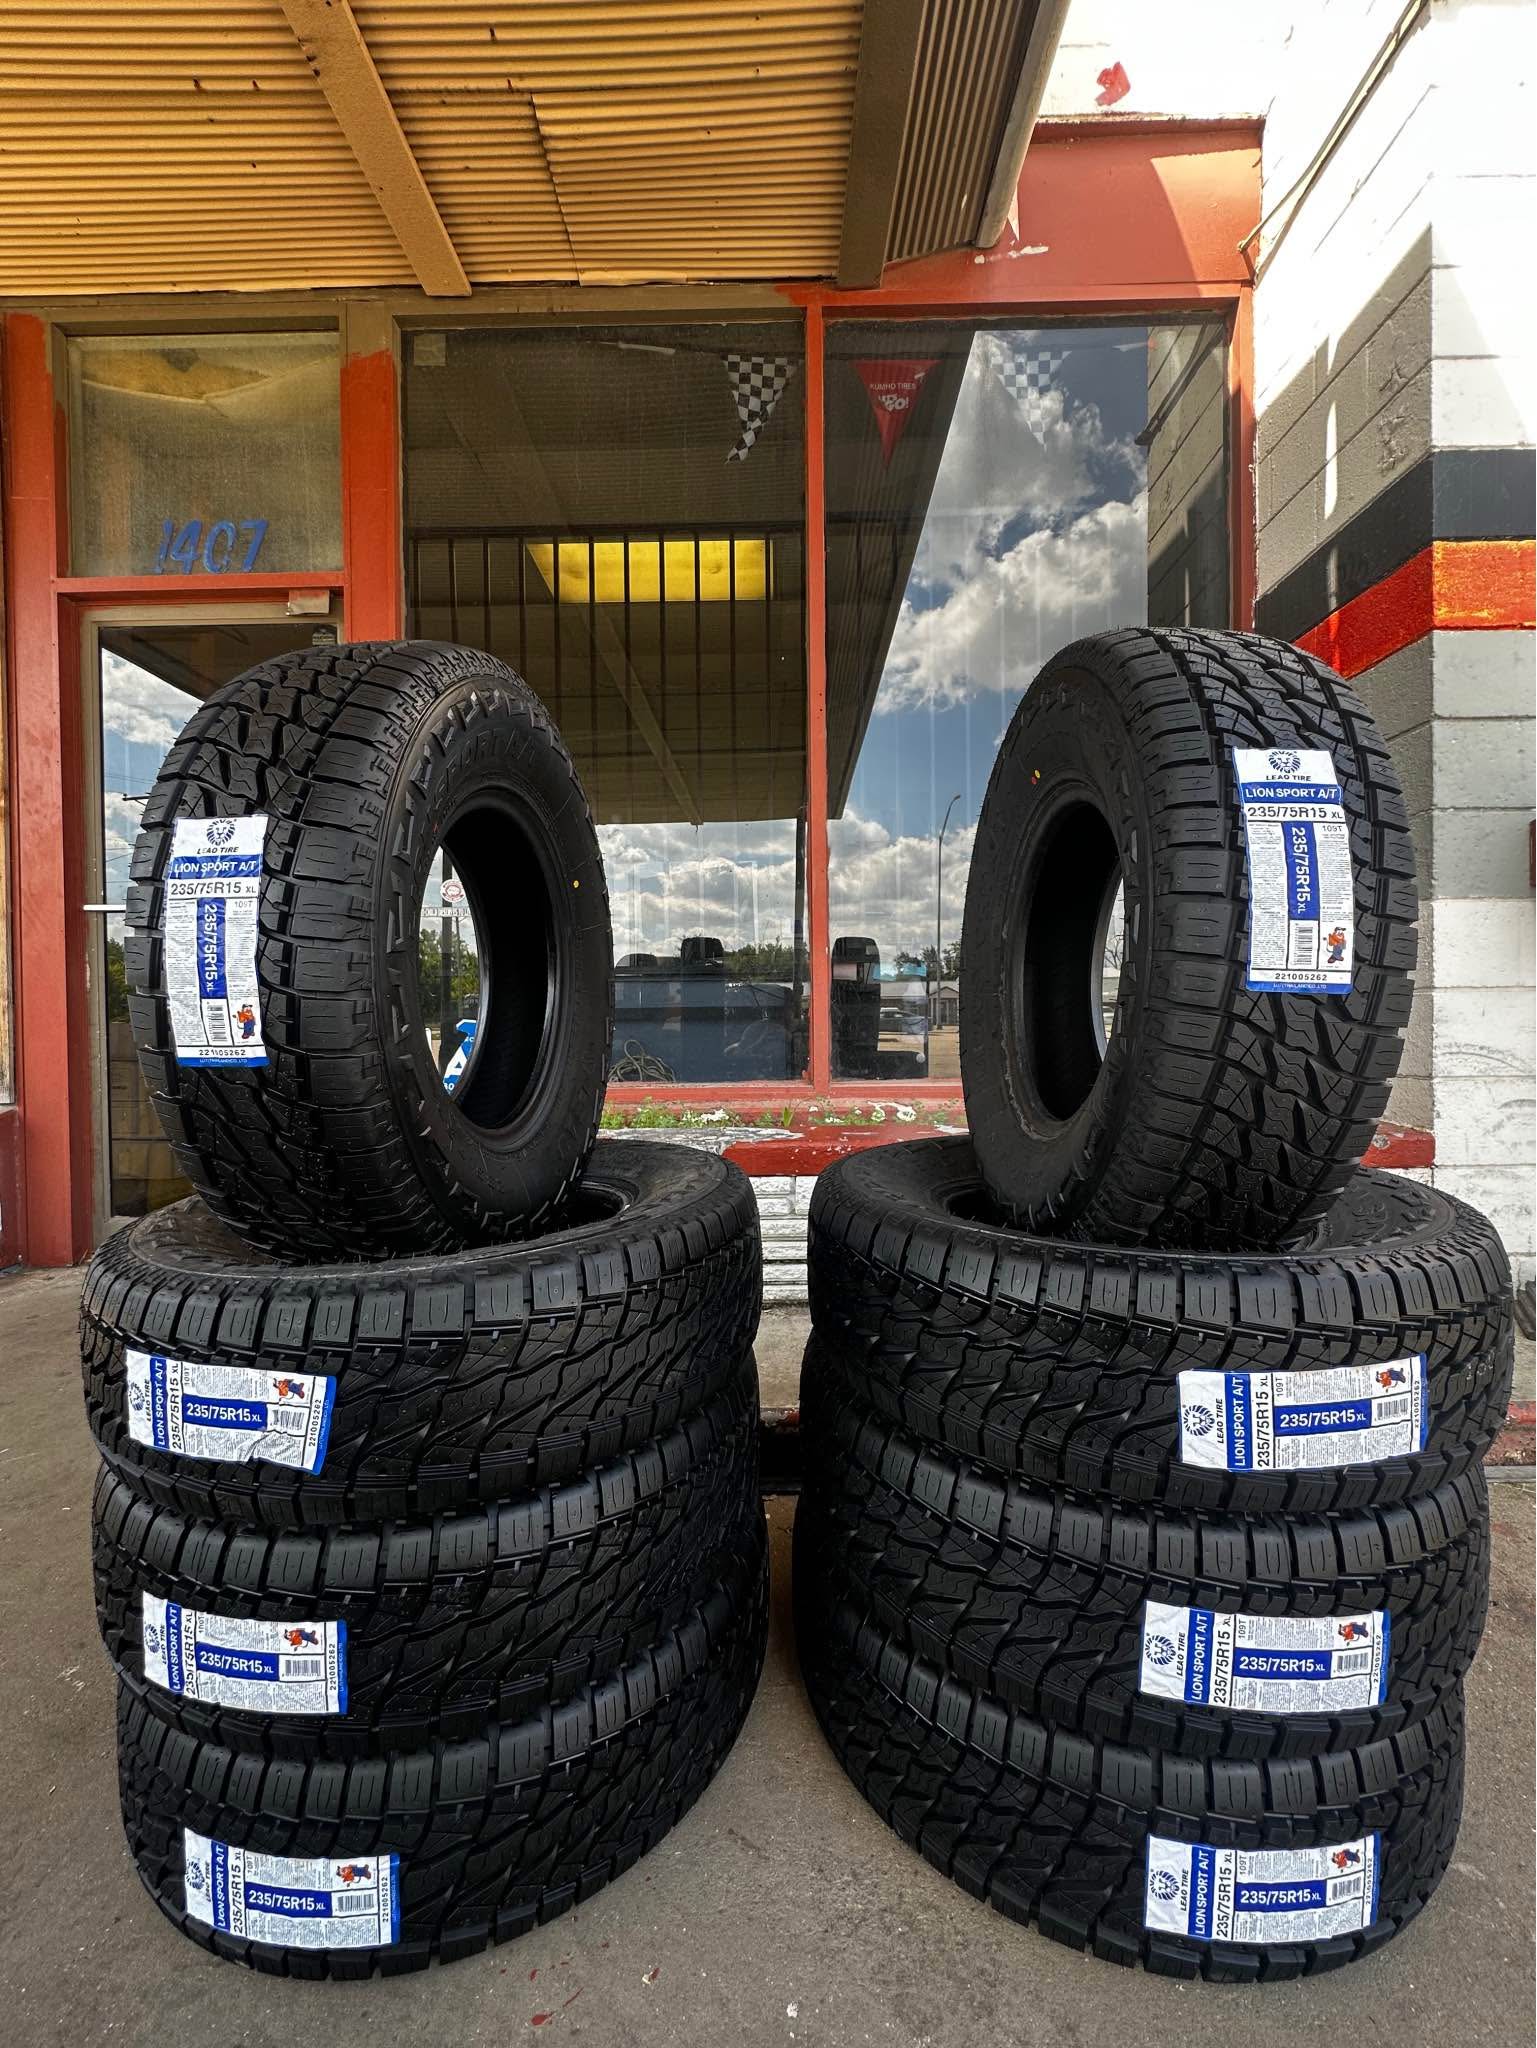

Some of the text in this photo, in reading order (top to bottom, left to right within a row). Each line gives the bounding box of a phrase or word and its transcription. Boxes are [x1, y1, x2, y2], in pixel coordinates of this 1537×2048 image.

[151, 518, 270, 575] 1407
[1245, 788, 1338, 799] LION SPORT A/T
[1247, 806, 1344, 819] 235/75R15 XL
[174, 860, 257, 873] LION SPORT A/T
[1291, 827, 1311, 914] 235/75R15 XL
[170, 881, 257, 895] 235/75R15 XL
[204, 904, 218, 992] 235/75R15 XL
[1274, 972, 1328, 981] 221005262
[1275, 1377, 1284, 1397] 109T
[154, 1360, 166, 1445] LION SPORT A/T
[169, 1363, 182, 1449] 235/75R15 XL
[187, 1402, 262, 1422] 235/75R15 XL
[1215, 1398, 1223, 1418] TIRE
[308, 1399, 322, 1447] 221005262
[1232, 1377, 1246, 1466] LION SPORT A/T
[1255, 1375, 1270, 1467] 235/75R15 XL
[1279, 1408, 1367, 1428] 235/75R15 XL
[185, 1612, 193, 1624] XL
[1238, 1619, 1247, 1640] 109T
[169, 1607, 181, 1689] LION SPORT A/T
[1178, 1632, 1186, 1651] TIRE
[199, 1651, 274, 1674] 235/75R15 XL
[328, 1643, 336, 1691] 221005262
[1191, 1614, 1209, 1700] LION SPORT A/T
[1213, 1616, 1231, 1704] 235/75R15 XL
[1239, 1656, 1326, 1672] 235/75R15 XL
[1239, 1855, 1247, 1875] 109T
[215, 1845, 226, 1926] LION SPORT A/T
[1181, 1868, 1189, 1887] TIRE
[231, 1850, 243, 1934] 235/75R15 XL
[248, 1889, 325, 1911] 235/75R15 XL
[1194, 1850, 1210, 1935] LION SPORT A/T
[1216, 1851, 1233, 1937] 235/75R15 XL
[1240, 1888, 1321, 1905] 235/75R15 XL
